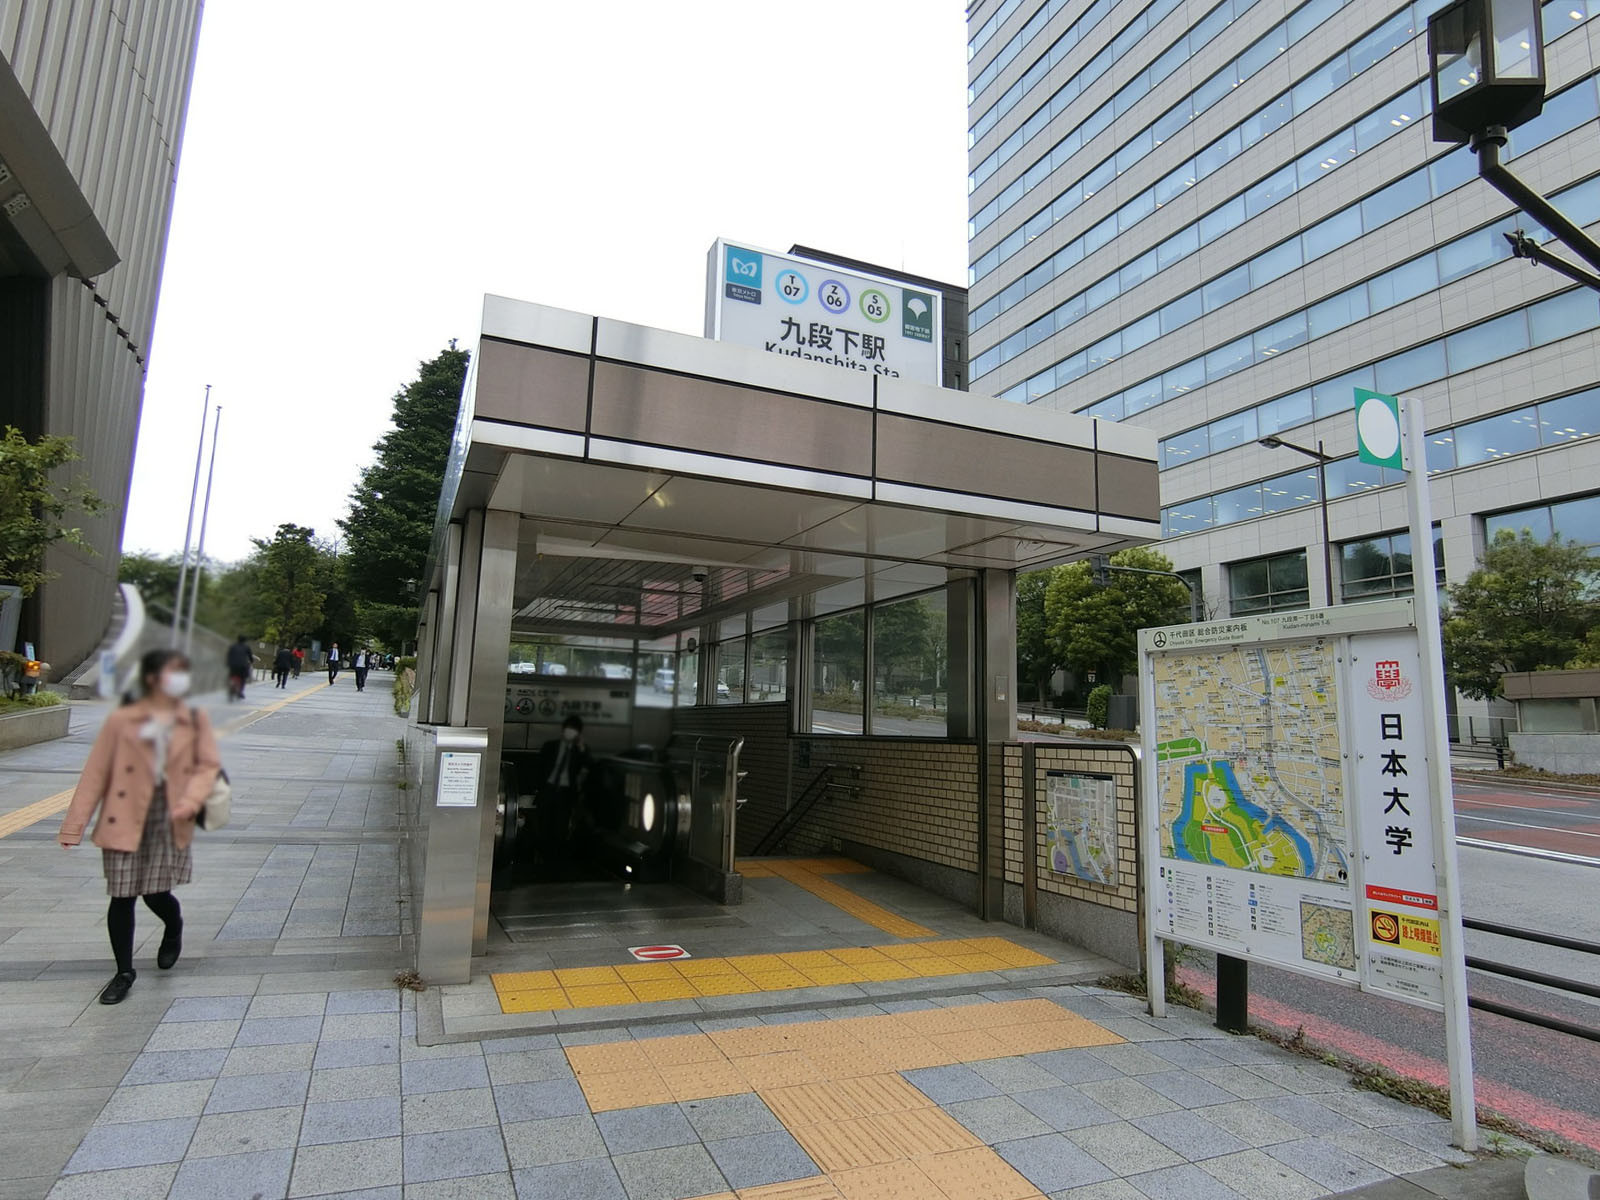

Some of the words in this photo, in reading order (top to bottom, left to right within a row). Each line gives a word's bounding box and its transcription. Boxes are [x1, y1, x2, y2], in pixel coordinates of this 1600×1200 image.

[789, 275, 796, 285] T
[784, 286, 800, 297] 07
[831, 285, 838, 294] Z
[826, 295, 843, 308] 06
[871, 294, 879, 304] S
[867, 304, 883, 316] 05
[780, 317, 886, 362] 九段下駅
[1169, 628, 1195, 639] 千代田区
[1380, 713, 1413, 856] 日本大学
